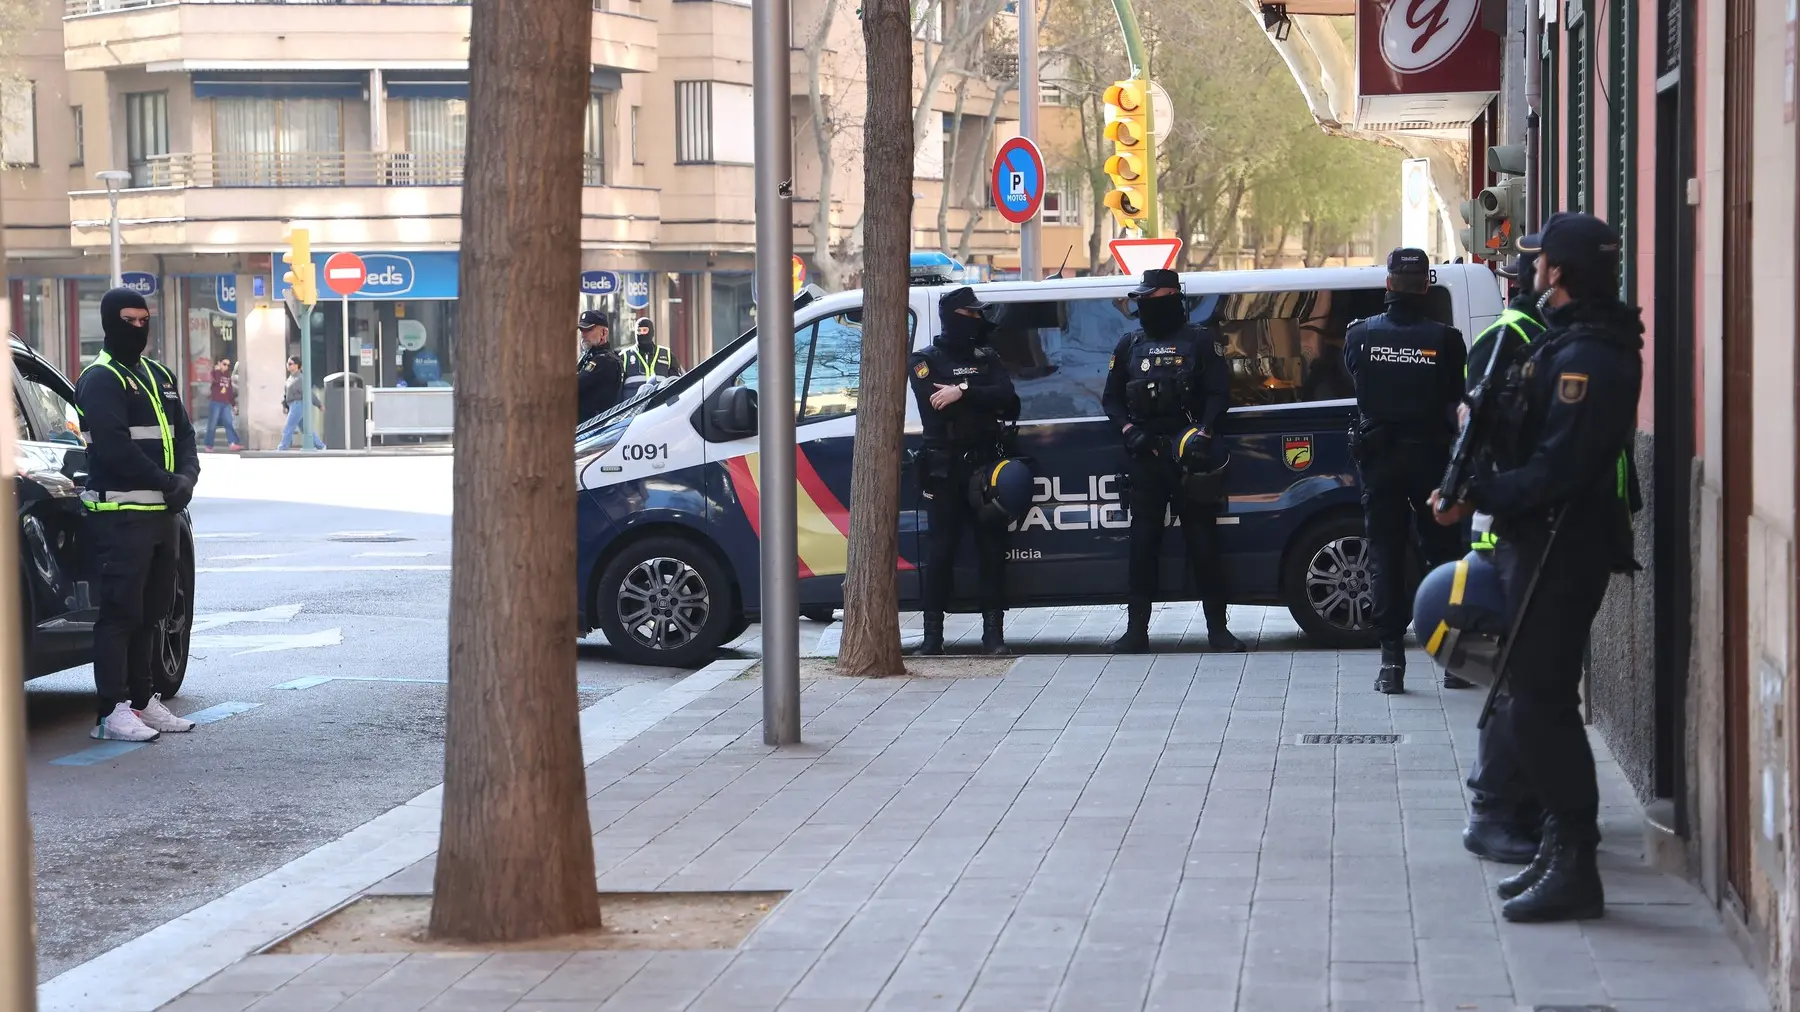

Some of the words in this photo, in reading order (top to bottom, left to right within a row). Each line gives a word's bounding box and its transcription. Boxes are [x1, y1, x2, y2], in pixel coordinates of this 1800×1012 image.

[1013, 174, 1021, 190] P
[1007, 194, 1027, 202] MOTOS
[364, 265, 404, 285] ed's
[221, 277, 236, 302] be
[1370, 346, 1423, 356] POLICIA
[1370, 354, 1436, 365] NACIONAL
[630, 443, 668, 460] 091
[1032, 474, 1121, 502] OLIC
[1005, 548, 1042, 560] olicia
